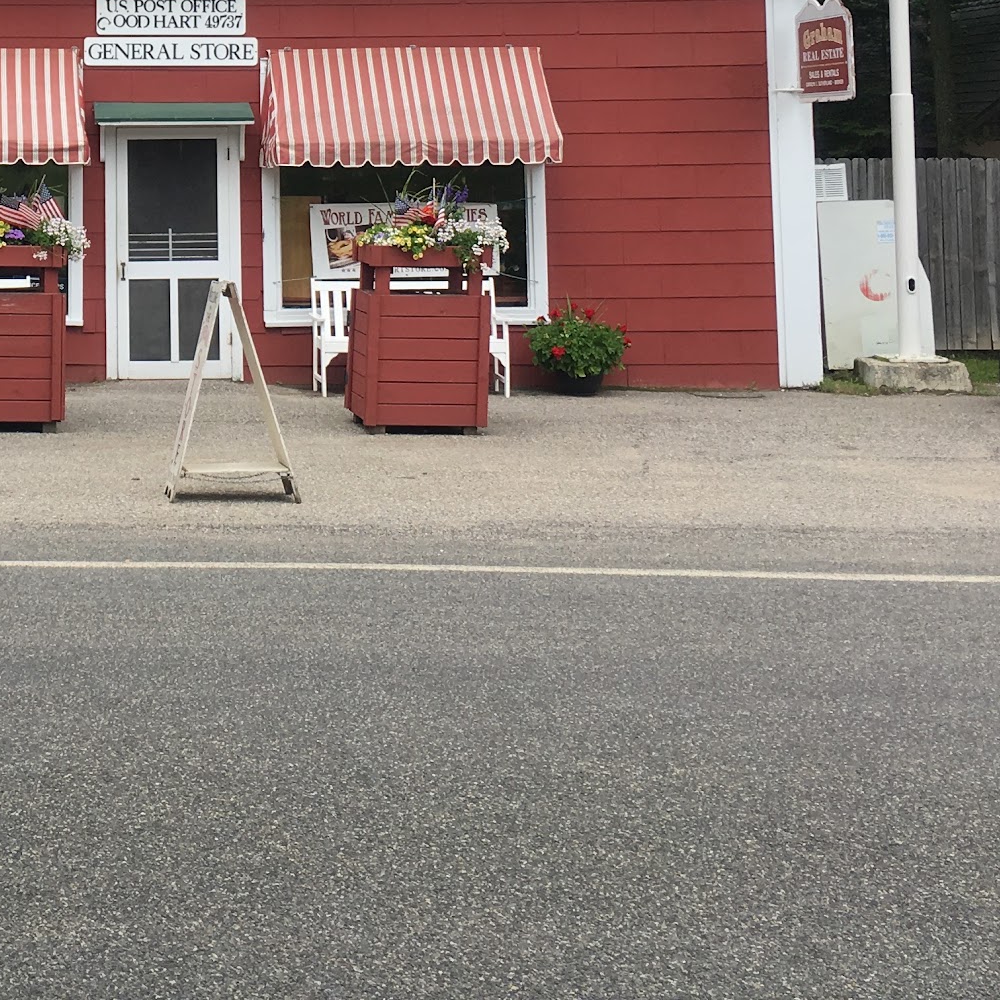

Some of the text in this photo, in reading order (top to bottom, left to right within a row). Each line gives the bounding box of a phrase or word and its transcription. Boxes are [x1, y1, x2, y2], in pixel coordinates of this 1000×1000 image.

[134, 0, 176, 14] POST
[181, 0, 237, 13] OFFICE
[154, 14, 201, 28] HART
[204, 14, 243, 28] 49737
[802, 22, 843, 50] Graham
[88, 43, 254, 60] GENERAL STORE
[802, 47, 844, 62] REAL ESTATE
[320, 208, 363, 226] WORLD
